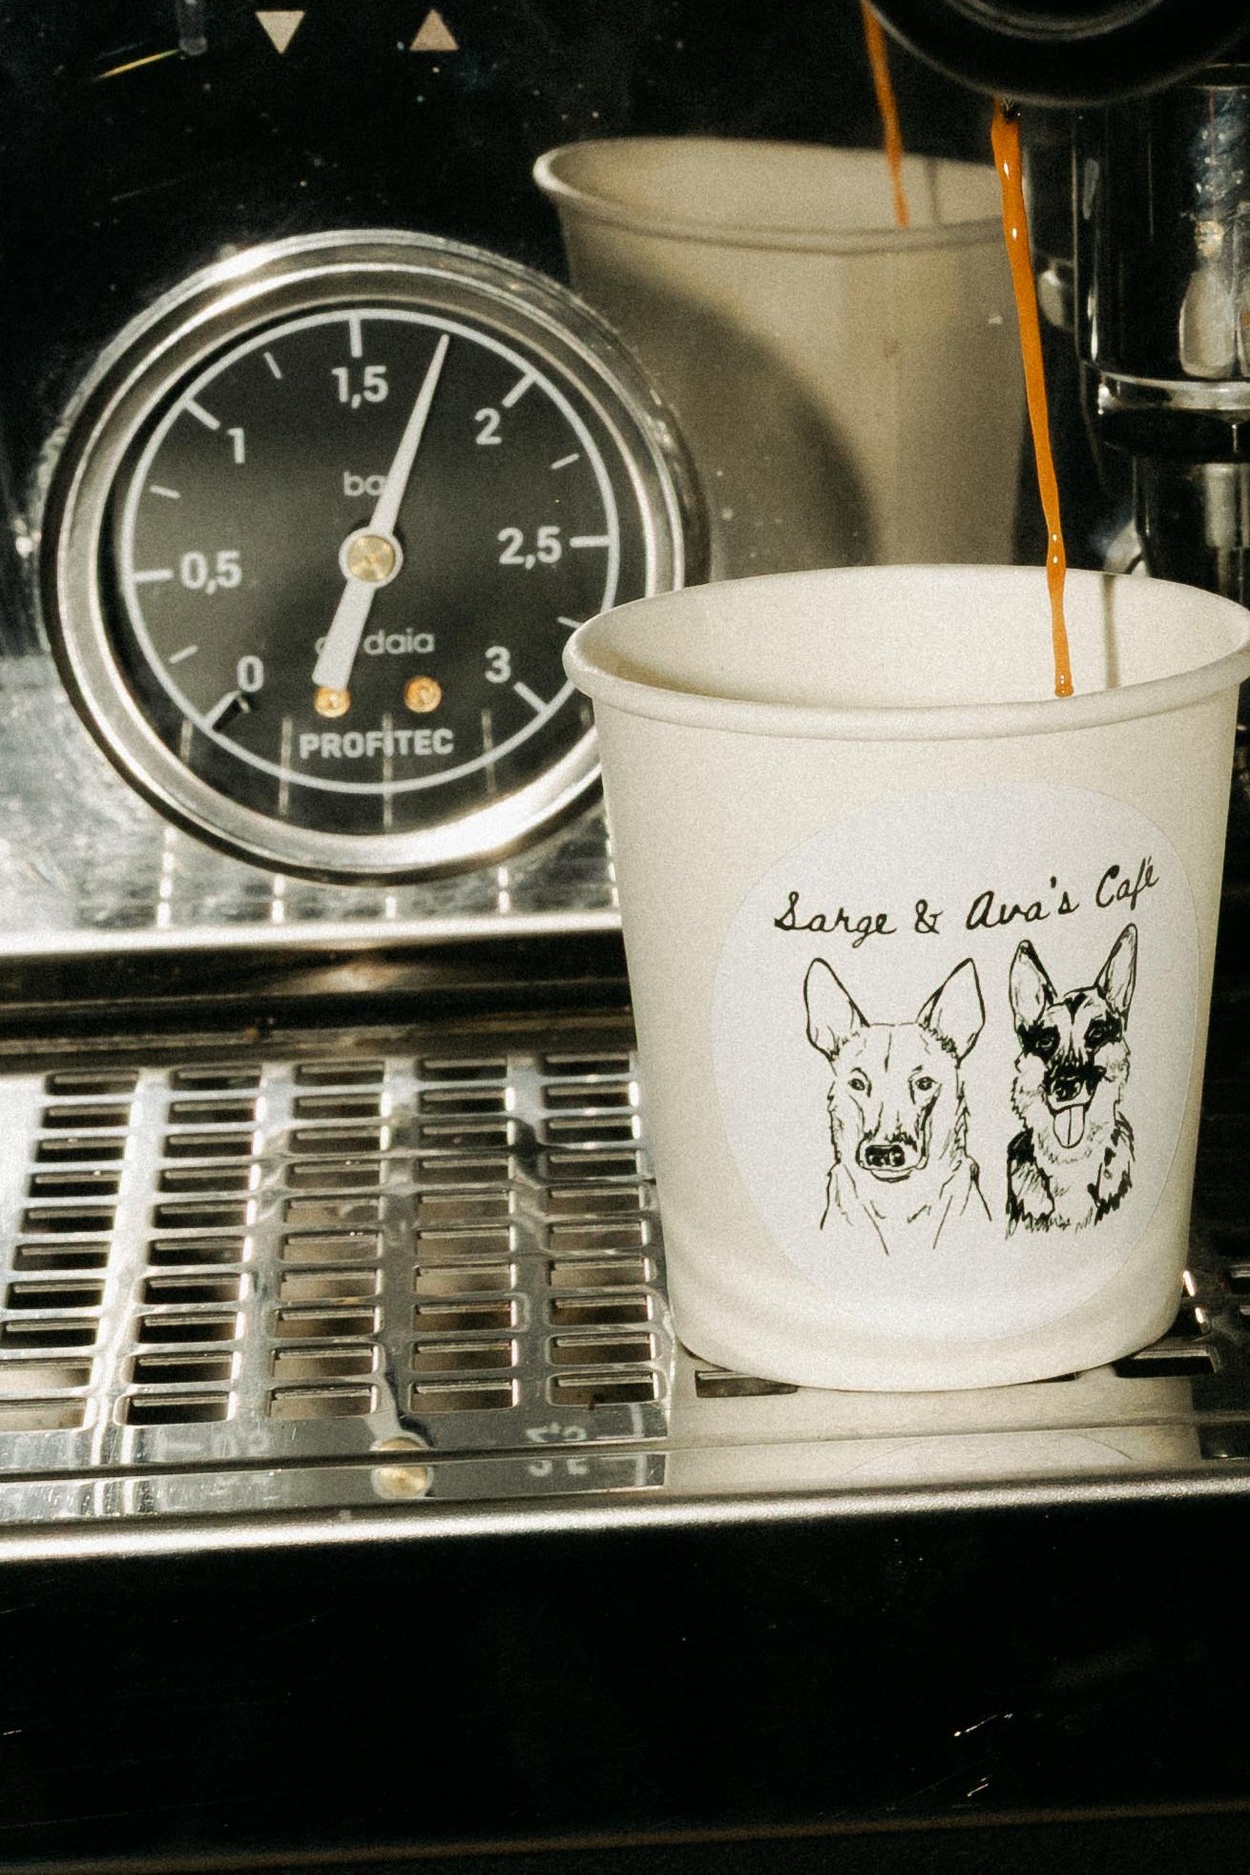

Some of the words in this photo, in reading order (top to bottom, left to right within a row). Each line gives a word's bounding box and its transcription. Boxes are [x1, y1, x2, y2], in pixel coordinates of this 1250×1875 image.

[332, 366, 389, 409] 1,5
[475, 408, 502, 445] 2
[227, 428, 245, 464] 1
[344, 471, 387, 496] ba
[498, 526, 562, 570] 2,5
[180, 550, 243, 595] 0,5
[236, 655, 265, 693] 0
[485, 645, 512, 684] 3
[300, 728, 455, 759] PROFITEC
[774, 890, 898, 949] Sarge
[914, 899, 944, 934] &
[965, 876, 1080, 931] Ava's
